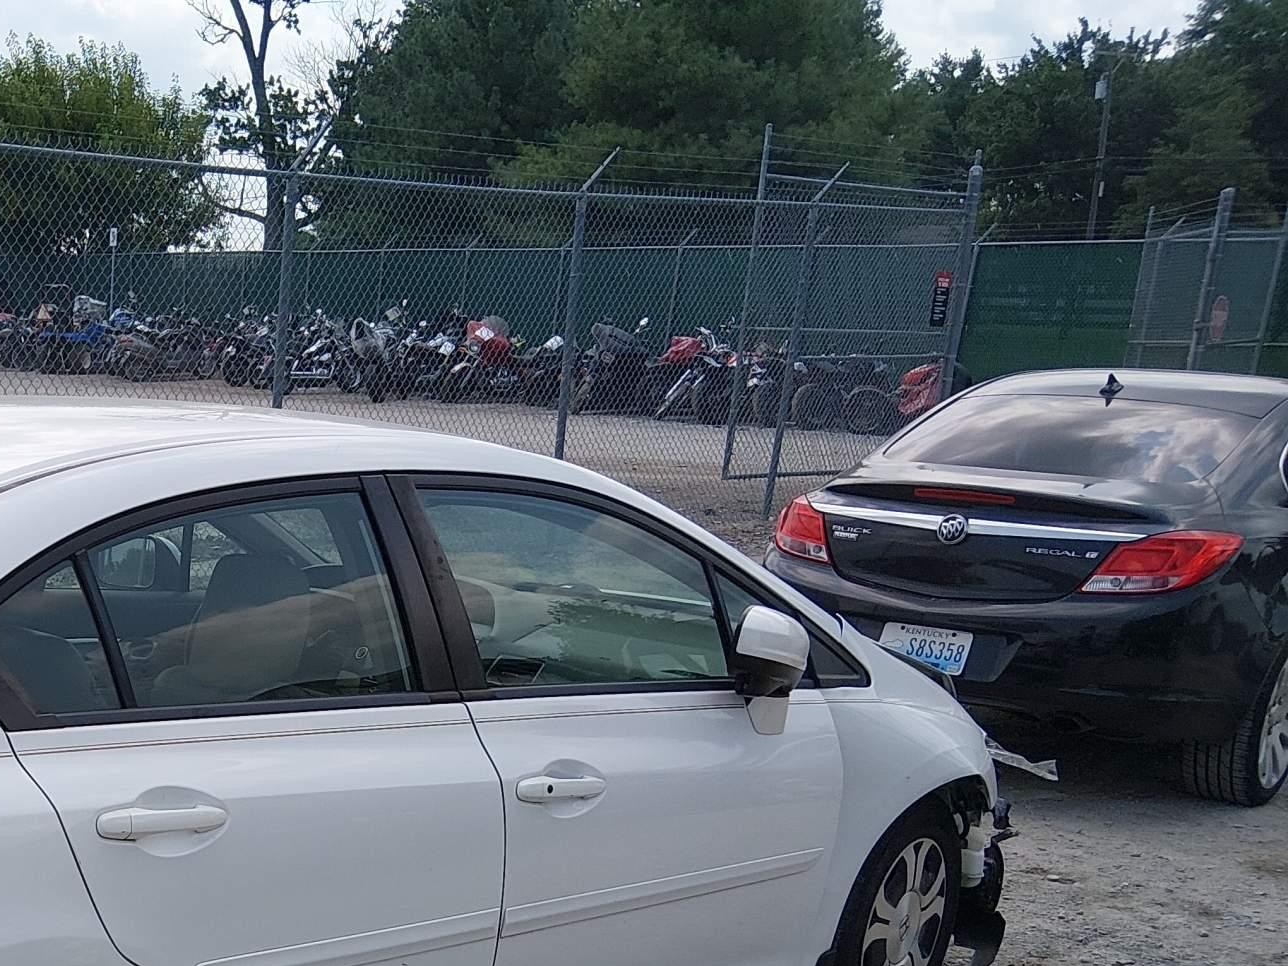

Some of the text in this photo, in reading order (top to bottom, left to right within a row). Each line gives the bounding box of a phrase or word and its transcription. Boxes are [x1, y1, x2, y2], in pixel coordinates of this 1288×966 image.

[832, 524, 872, 535] BUICK
[1025, 547, 1082, 558] REGAL
[905, 627, 951, 639] KENTUCKY
[906, 637, 966, 663] S8S358
